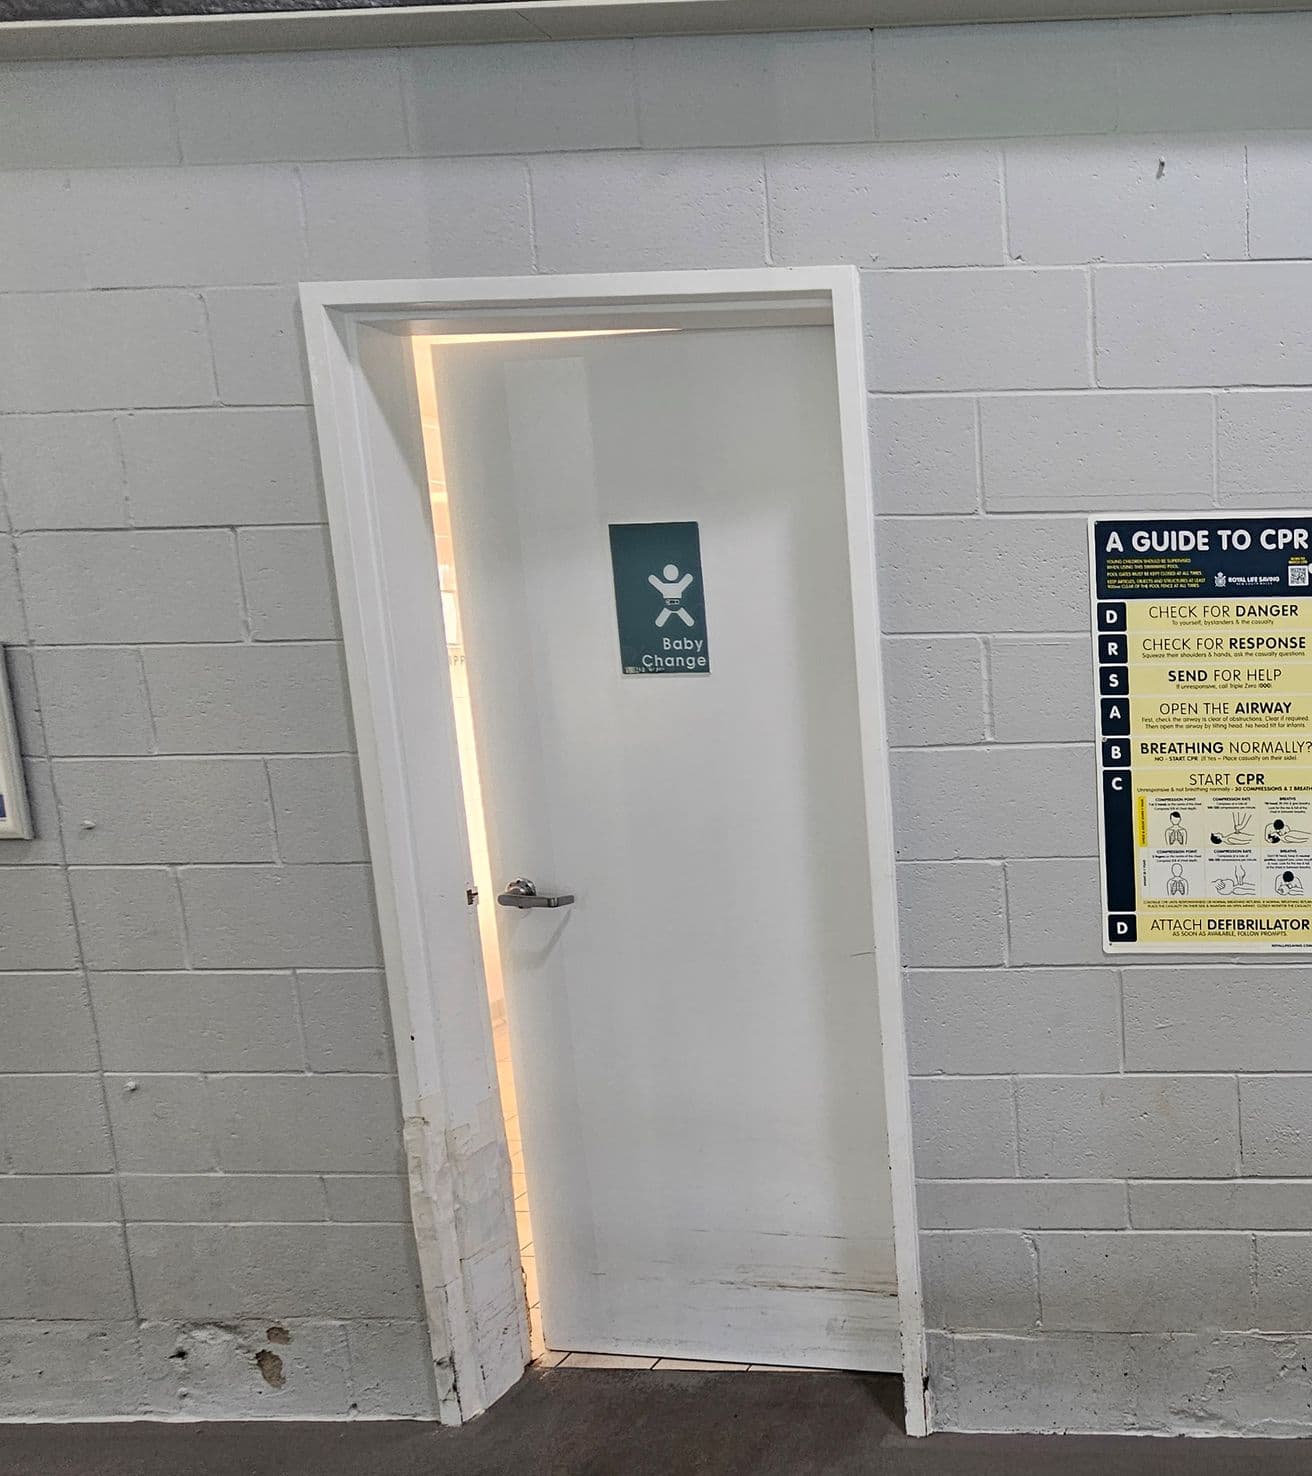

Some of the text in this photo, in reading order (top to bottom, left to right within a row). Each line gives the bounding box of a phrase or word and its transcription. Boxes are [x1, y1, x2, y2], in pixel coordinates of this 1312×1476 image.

[1105, 528, 1308, 553] A GUIDE TO CPR
[1106, 610, 1117, 624] D
[1149, 604, 1298, 619] CHECK FOR DANGER
[663, 637, 702, 652] Baby
[1108, 642, 1118, 656] R
[1143, 637, 1306, 651] CHECK FOR RESPONSE
[642, 655, 706, 669] Change
[1109, 674, 1119, 687] S
[1168, 669, 1281, 682] SEND FOR HELP
[1110, 705, 1121, 719] A
[1160, 702, 1291, 715] OPEN THE AIRWAY
[1111, 746, 1121, 759] B
[1141, 741, 1312, 754] BREATHING NORMALLY?
[1112, 777, 1122, 790] C
[1190, 773, 1264, 786] START CPR
[1117, 922, 1128, 934] D
[1151, 919, 1310, 931] ATTACH DEFIBRILLATOR
